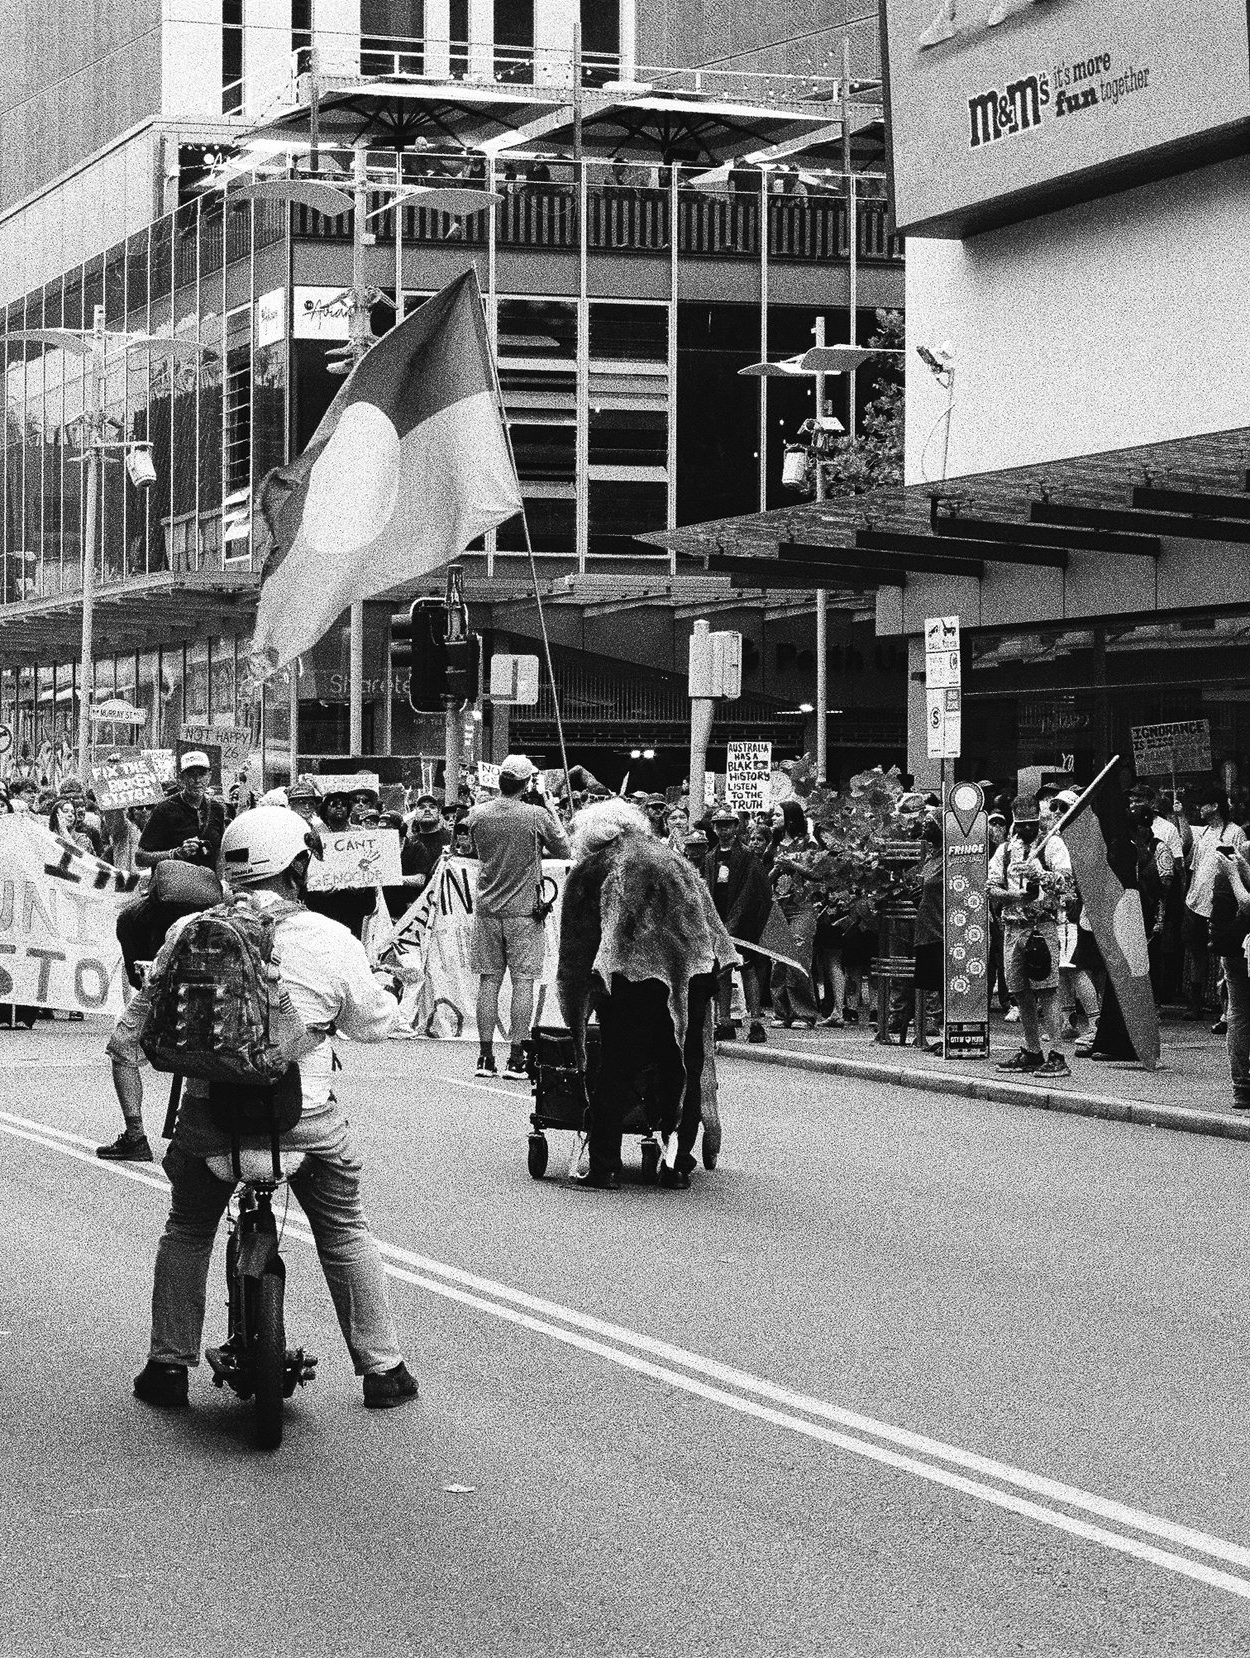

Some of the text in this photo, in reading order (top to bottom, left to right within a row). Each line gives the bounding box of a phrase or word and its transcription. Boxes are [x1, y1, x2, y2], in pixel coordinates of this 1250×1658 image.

[1053, 52, 1111, 90] it's more
[1055, 67, 1150, 117] fun together
[100, 709, 124, 718] MURRAY
[185, 727, 249, 744] NOT HAPPY
[1133, 722, 1205, 740] IGNORANCE
[728, 743, 769, 753] AUSTRALIA
[1132, 741, 1144, 751] IS
[752, 752, 759, 760] A
[91, 763, 119, 783] FIX
[120, 760, 148, 777] THE
[728, 761, 752, 771] BLAK
[728, 782, 757, 792] LISTEN
[100, 786, 155, 806] SYSTEM
[731, 791, 763, 799] TO THE
[731, 800, 763, 810] TRUTH
[334, 838, 376, 852] CANT
[948, 843, 984, 855] FRINGE
[309, 869, 383, 889] GENOCIDE
